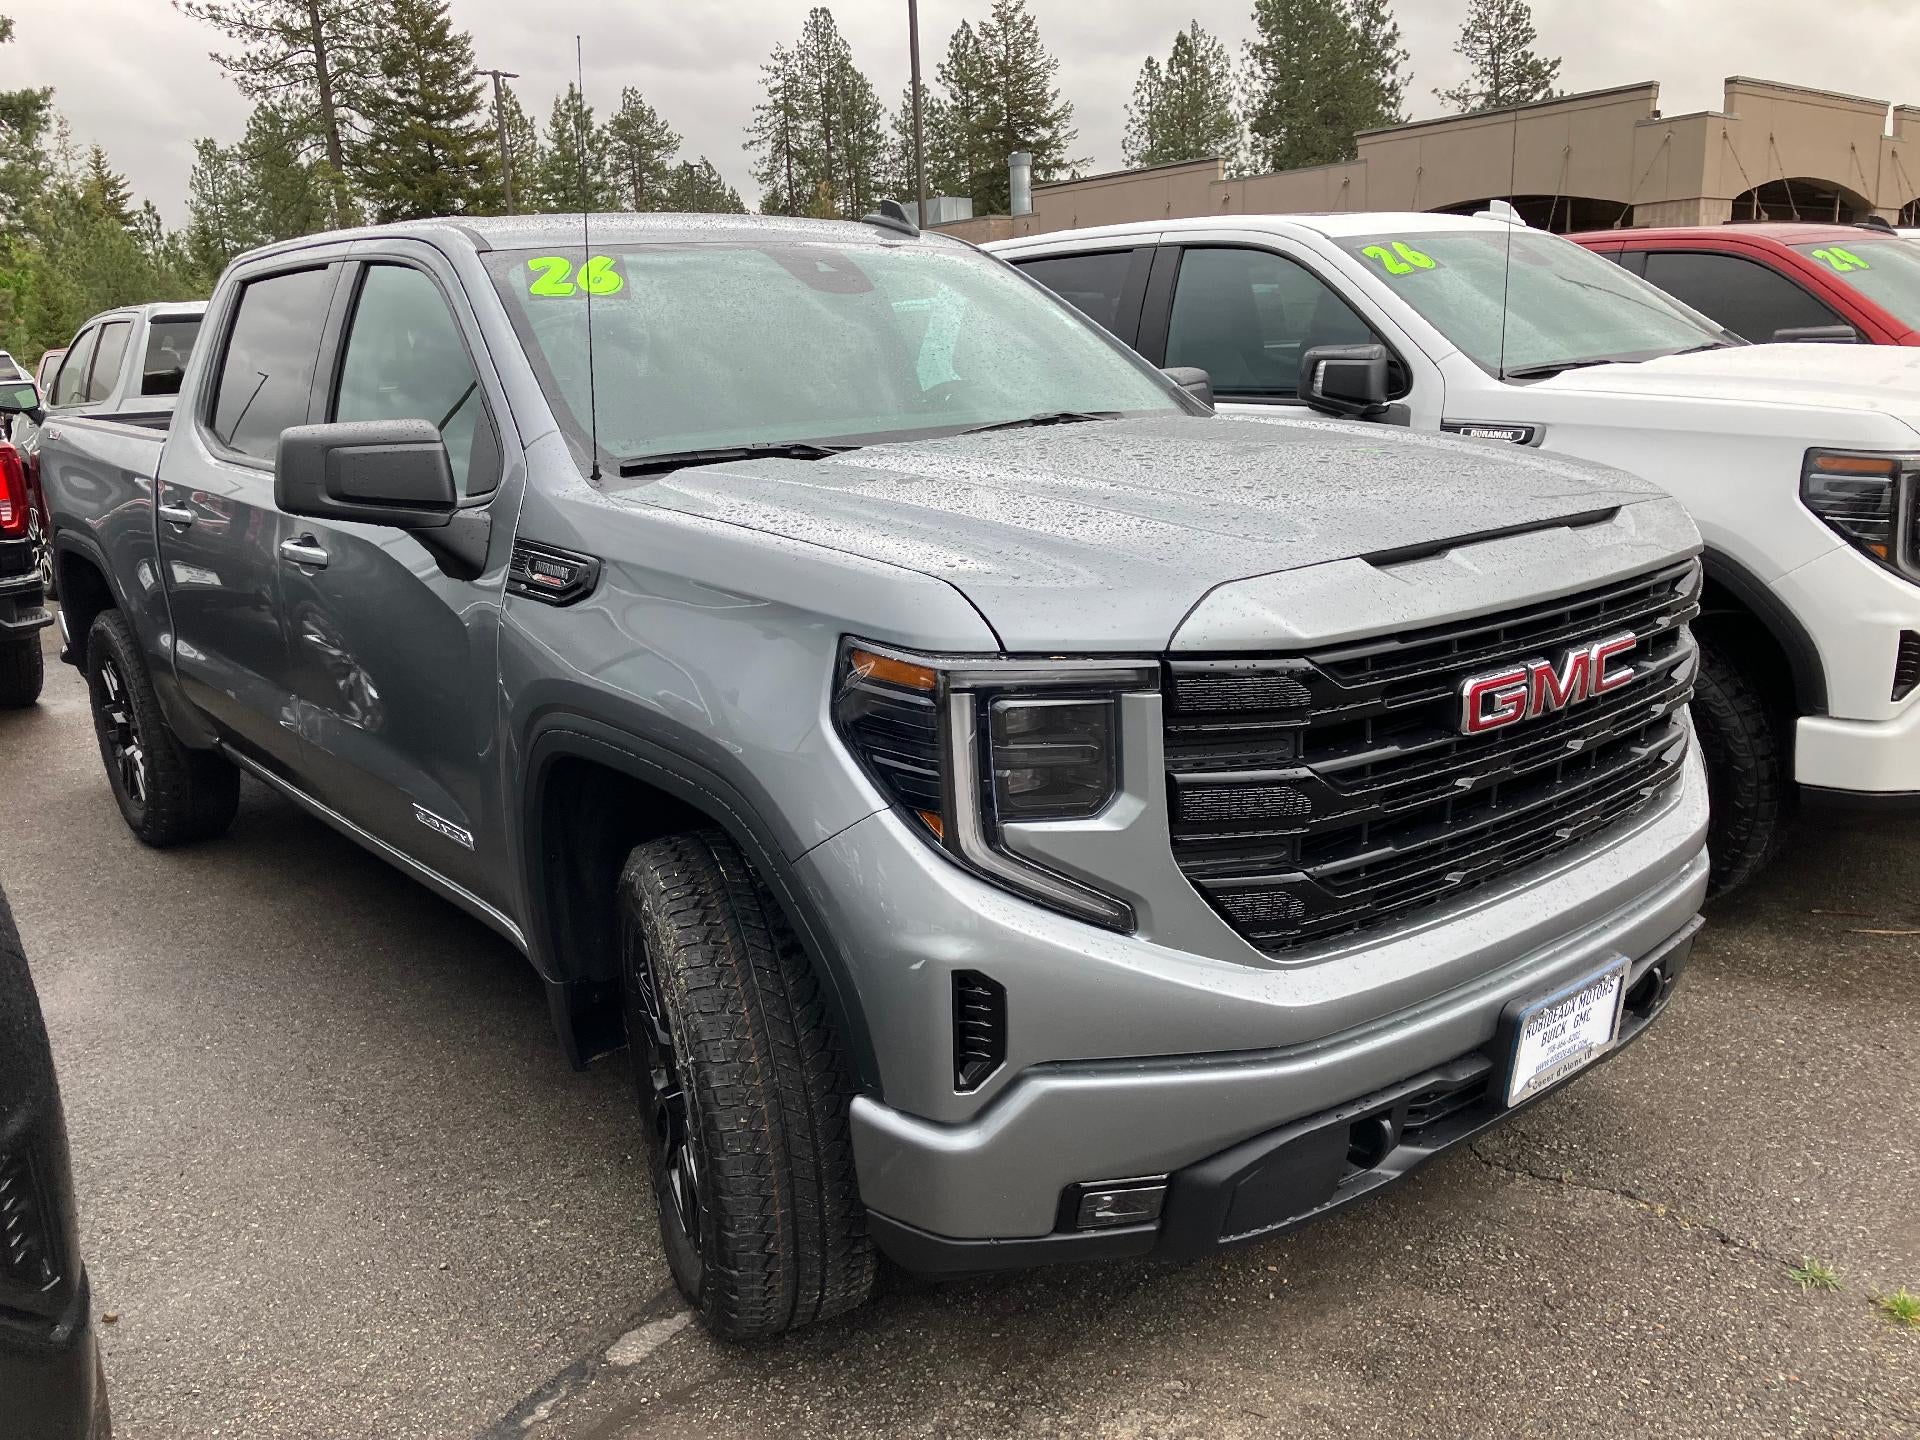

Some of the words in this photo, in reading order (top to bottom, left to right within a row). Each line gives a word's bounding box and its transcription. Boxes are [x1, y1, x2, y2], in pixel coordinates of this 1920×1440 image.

[1362, 241, 1436, 275] 26
[1811, 246, 1871, 272] 24
[527, 255, 625, 297] 26
[1470, 430, 1514, 440] DURAMAX
[1460, 631, 1637, 736] GMC
[1579, 979, 1615, 1010] MOTORS
[1541, 1020, 1567, 1047] BUICK
[1573, 1006, 1592, 1029] GMC
